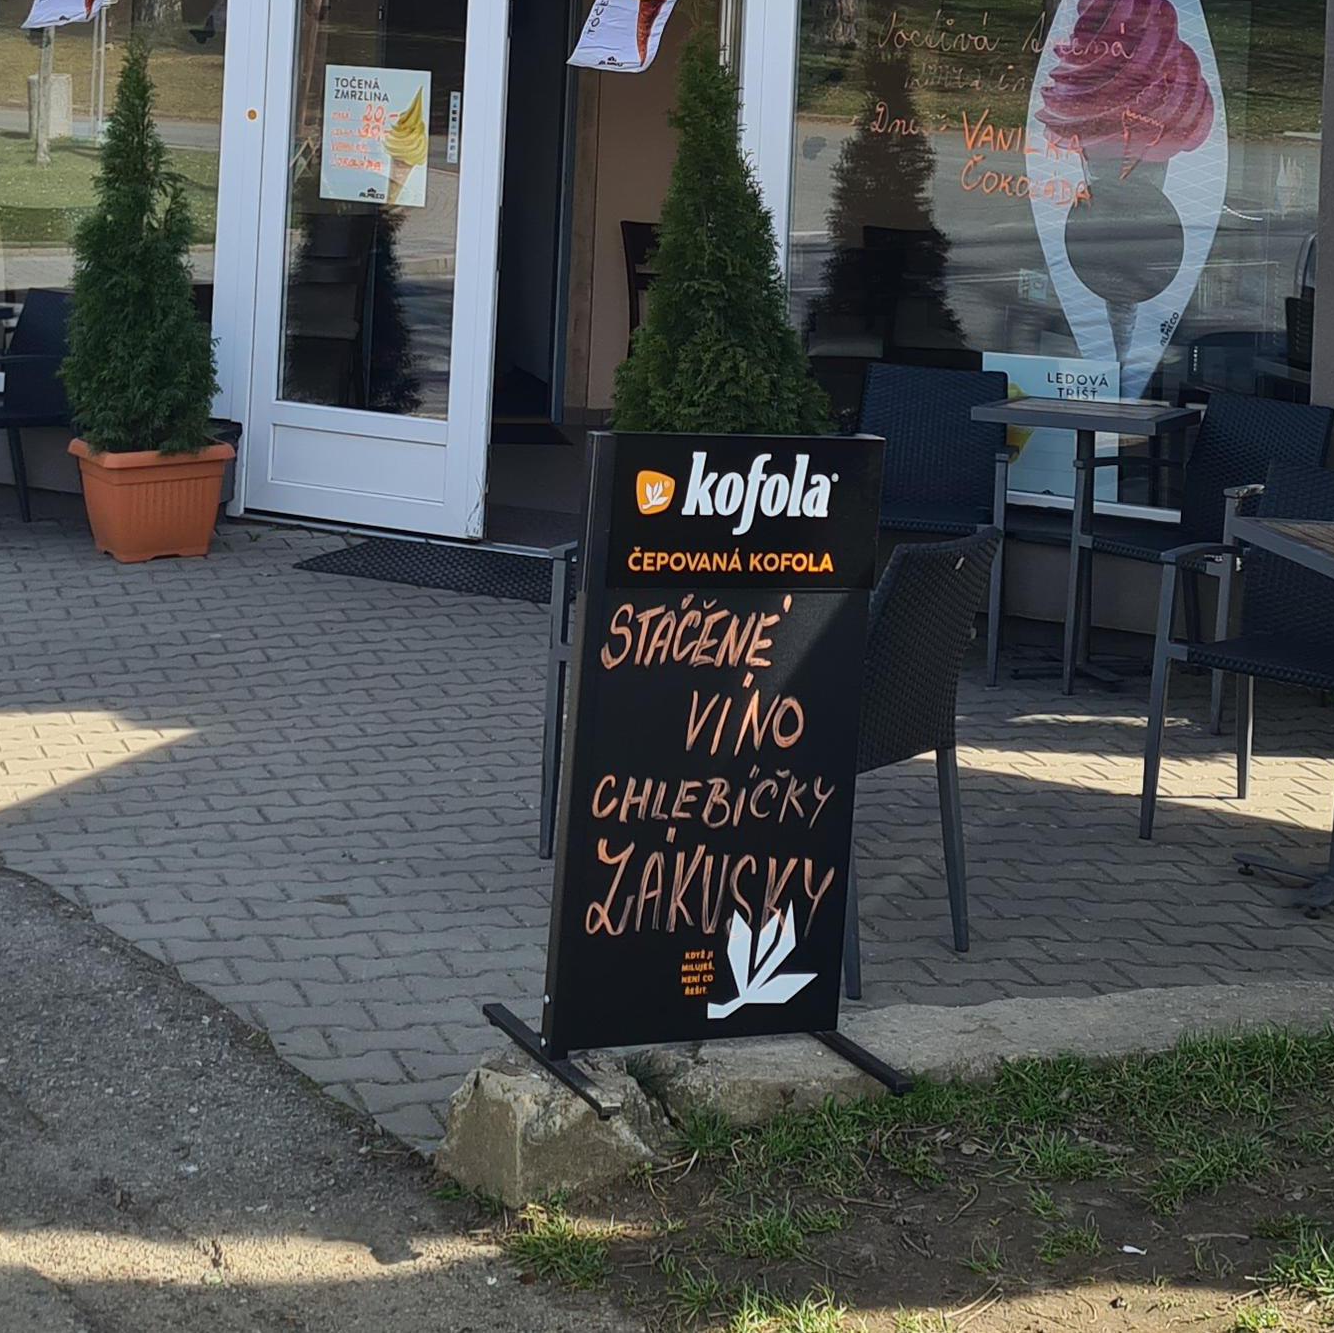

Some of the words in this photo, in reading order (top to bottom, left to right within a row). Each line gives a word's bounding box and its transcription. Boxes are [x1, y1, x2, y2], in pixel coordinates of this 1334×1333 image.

[334, 77, 380, 90] TOČENÁ
[334, 89, 389, 102] ZMRZLINA
[1047, 372, 1109, 388] LEDOVÁ
[681, 451, 832, 536] kofola
[627, 546, 742, 572] ČEPOVANÁ
[749, 552, 834, 573] KOFOLA
[591, 764, 835, 829] CHLEBÍČKY
[702, 974, 714, 983] CO
